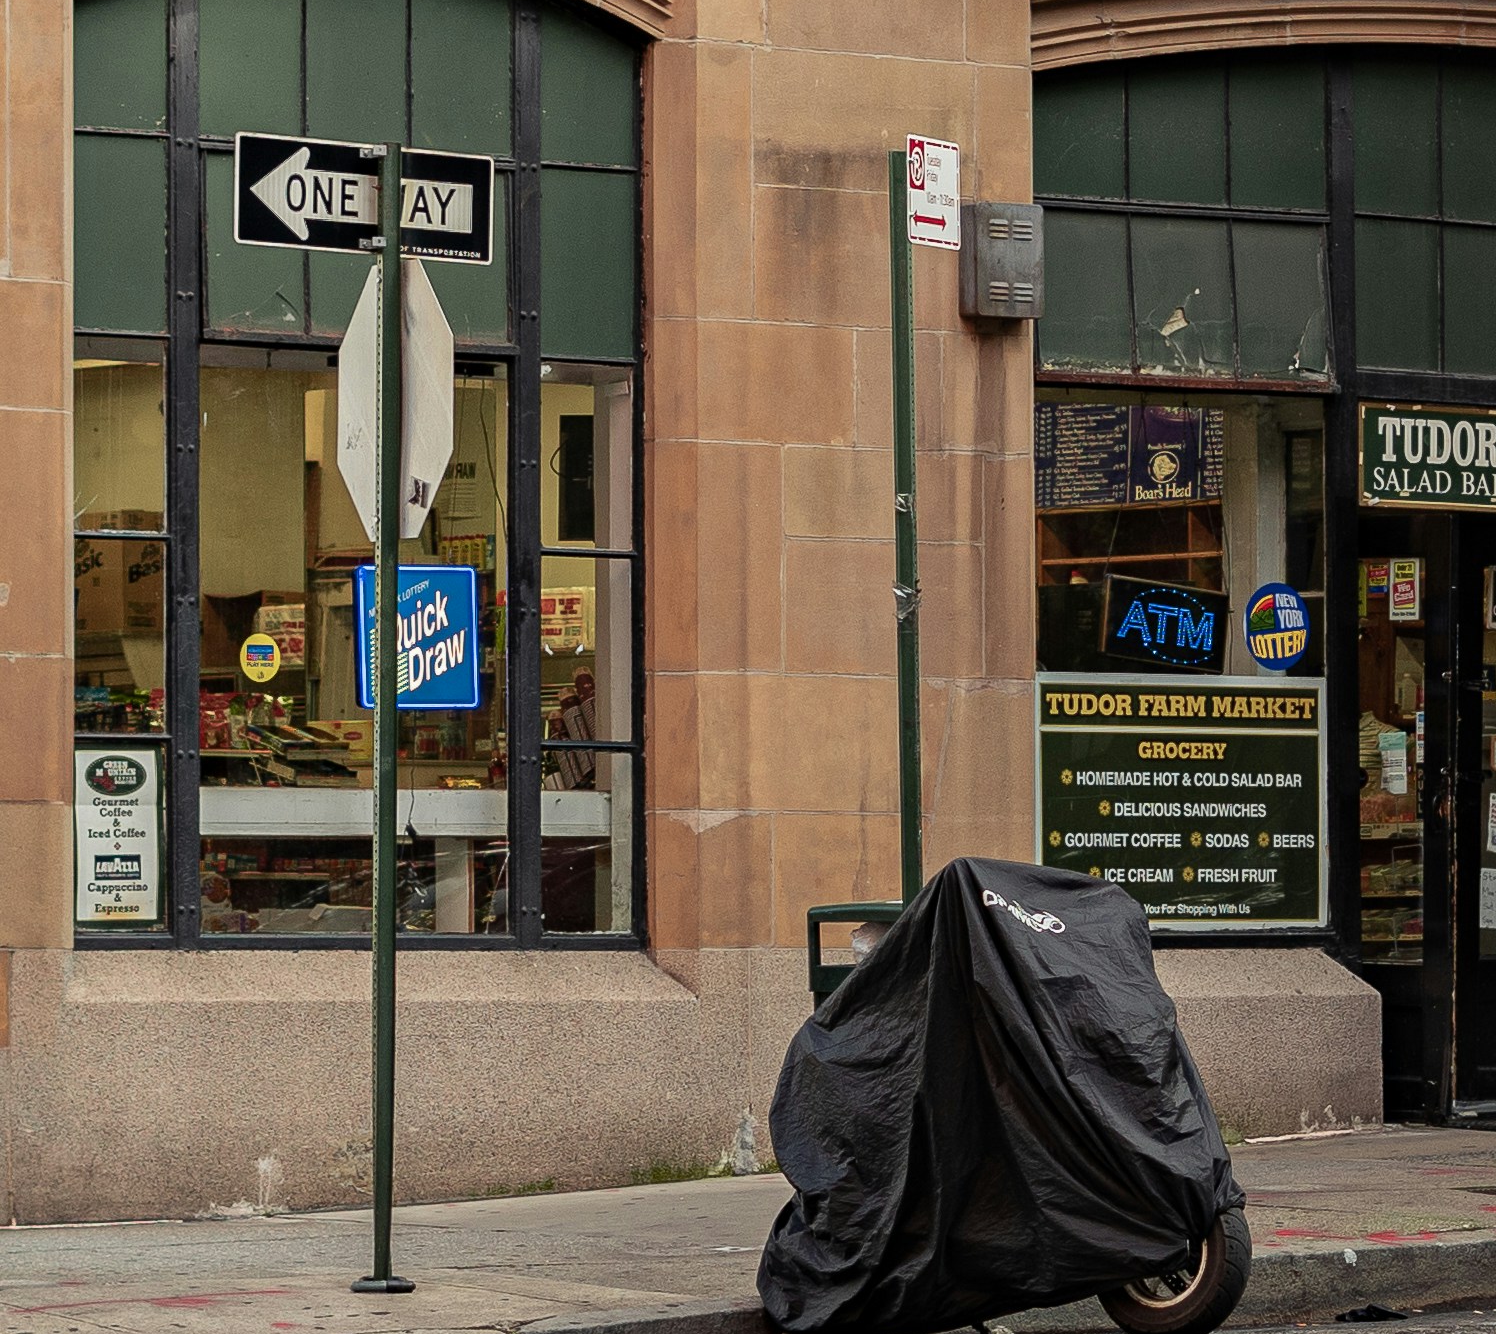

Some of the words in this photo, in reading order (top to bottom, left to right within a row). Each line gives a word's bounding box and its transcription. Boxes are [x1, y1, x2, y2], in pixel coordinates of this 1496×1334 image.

[286, 174, 359, 217] ONE
[400, 185, 456, 226] AY
[412, 246, 481, 258] TRANSPORTATION
[1373, 467, 1451, 495] SALAD
[1135, 484, 1163, 501] Boar's
[1165, 481, 1192, 499] Head
[402, 579, 430, 603] LOTTERY
[1275, 593, 1297, 608] NEW
[1116, 600, 1215, 651] ATM
[1277, 609, 1305, 629] YORK
[1250, 629, 1307, 659] LOTTERY
[408, 628, 466, 692] Draw
[1046, 693, 1132, 715] TUDOR
[1138, 695, 1207, 717] FARM
[1212, 696, 1316, 719] MARKET
[1138, 741, 1227, 760] GROCERY
[1076, 771, 1151, 787] HOMEMADE
[1153, 772, 1180, 787] HOT
[1181, 773, 1192, 787] &
[1194, 773, 1229, 787] COLD
[1231, 773, 1273, 788] SALAD
[1276, 773, 1302, 788] BAR
[92, 797, 139, 807] Gourmet
[1114, 802, 1181, 817] DELICIOUS
[99, 807, 133, 818] Coffee
[112, 818, 121, 828] &
[88, 828, 111, 838] Iced
[113, 828, 147, 838] Coffee
[1064, 833, 1129, 848] GOURMET
[1131, 833, 1182, 848] COFFEE
[1205, 834, 1249, 848] SODAS
[1273, 834, 1315, 849] BEERS
[95, 857, 140, 873] LAVAZZA
[1104, 868, 1125, 883] ICE
[1127, 869, 1174, 883] CREAM
[1197, 869, 1239, 883] FRESH
[1241, 869, 1277, 883] FRUIT
[87, 882, 149, 895] Cappuccino
[113, 893, 122, 903] &
[94, 903, 140, 915] Espresso
[1143, 903, 1160, 915] You
[1161, 904, 1176, 915] For
[1177, 904, 1217, 918] Shopping
[1218, 904, 1238, 915] With
[1238, 904, 1251, 915] Us
